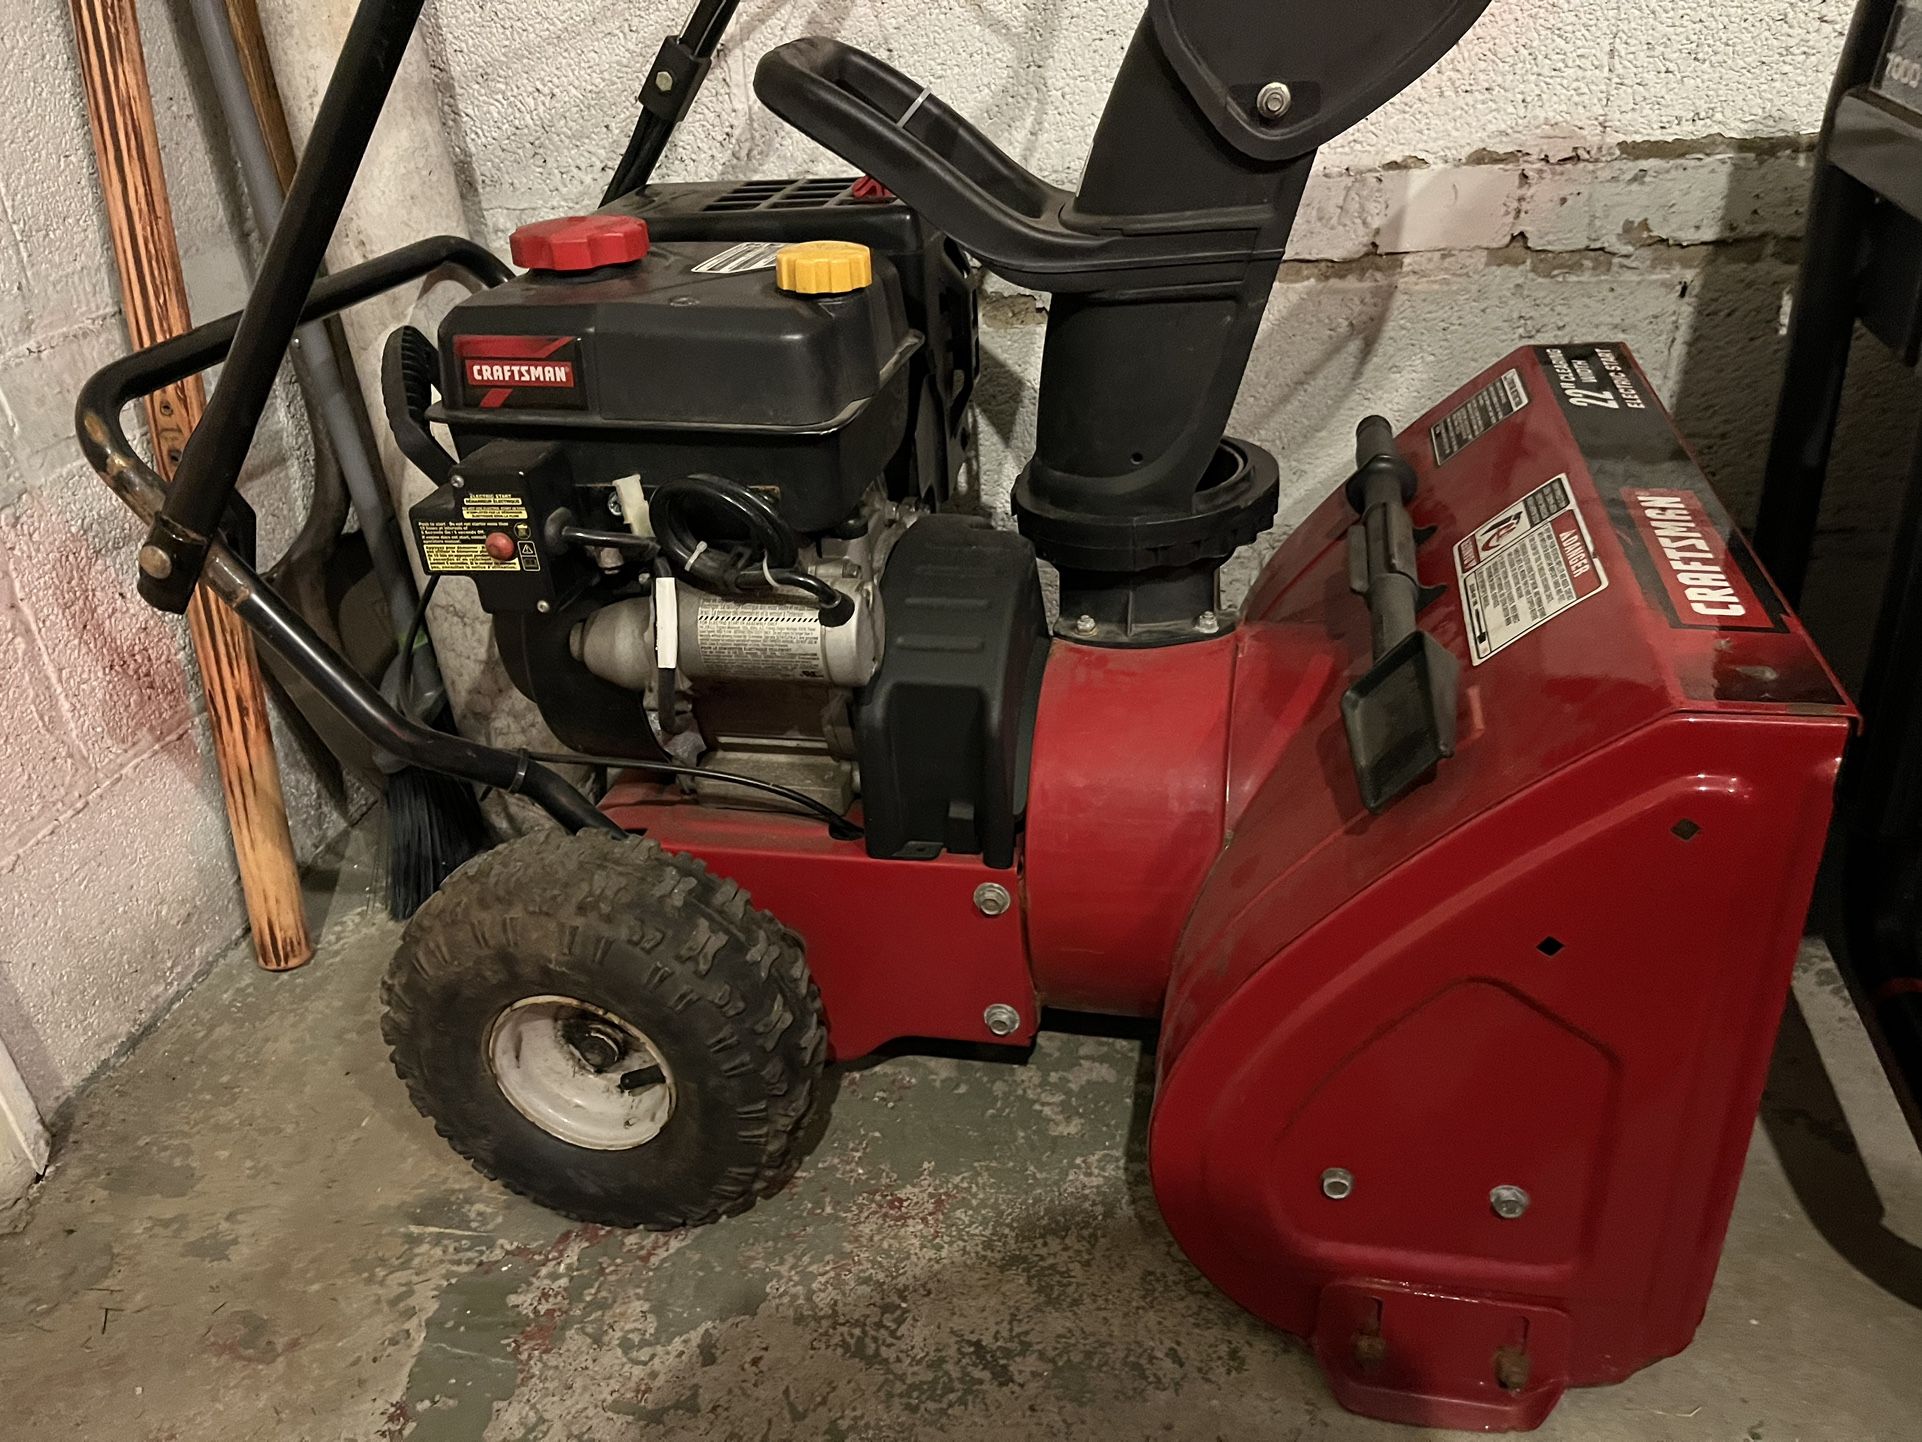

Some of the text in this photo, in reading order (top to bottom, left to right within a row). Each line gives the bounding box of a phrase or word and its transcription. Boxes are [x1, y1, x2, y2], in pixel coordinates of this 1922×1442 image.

[473, 364, 567, 382] CRAFTSMAN
[1546, 348, 1576, 381] CLEARING
[1571, 359, 1598, 383] WIDTH
[1594, 348, 1645, 409] ELECTRIC START
[1562, 535, 1590, 578] DANGER
[1636, 496, 1746, 616] CRAFTSMAN
